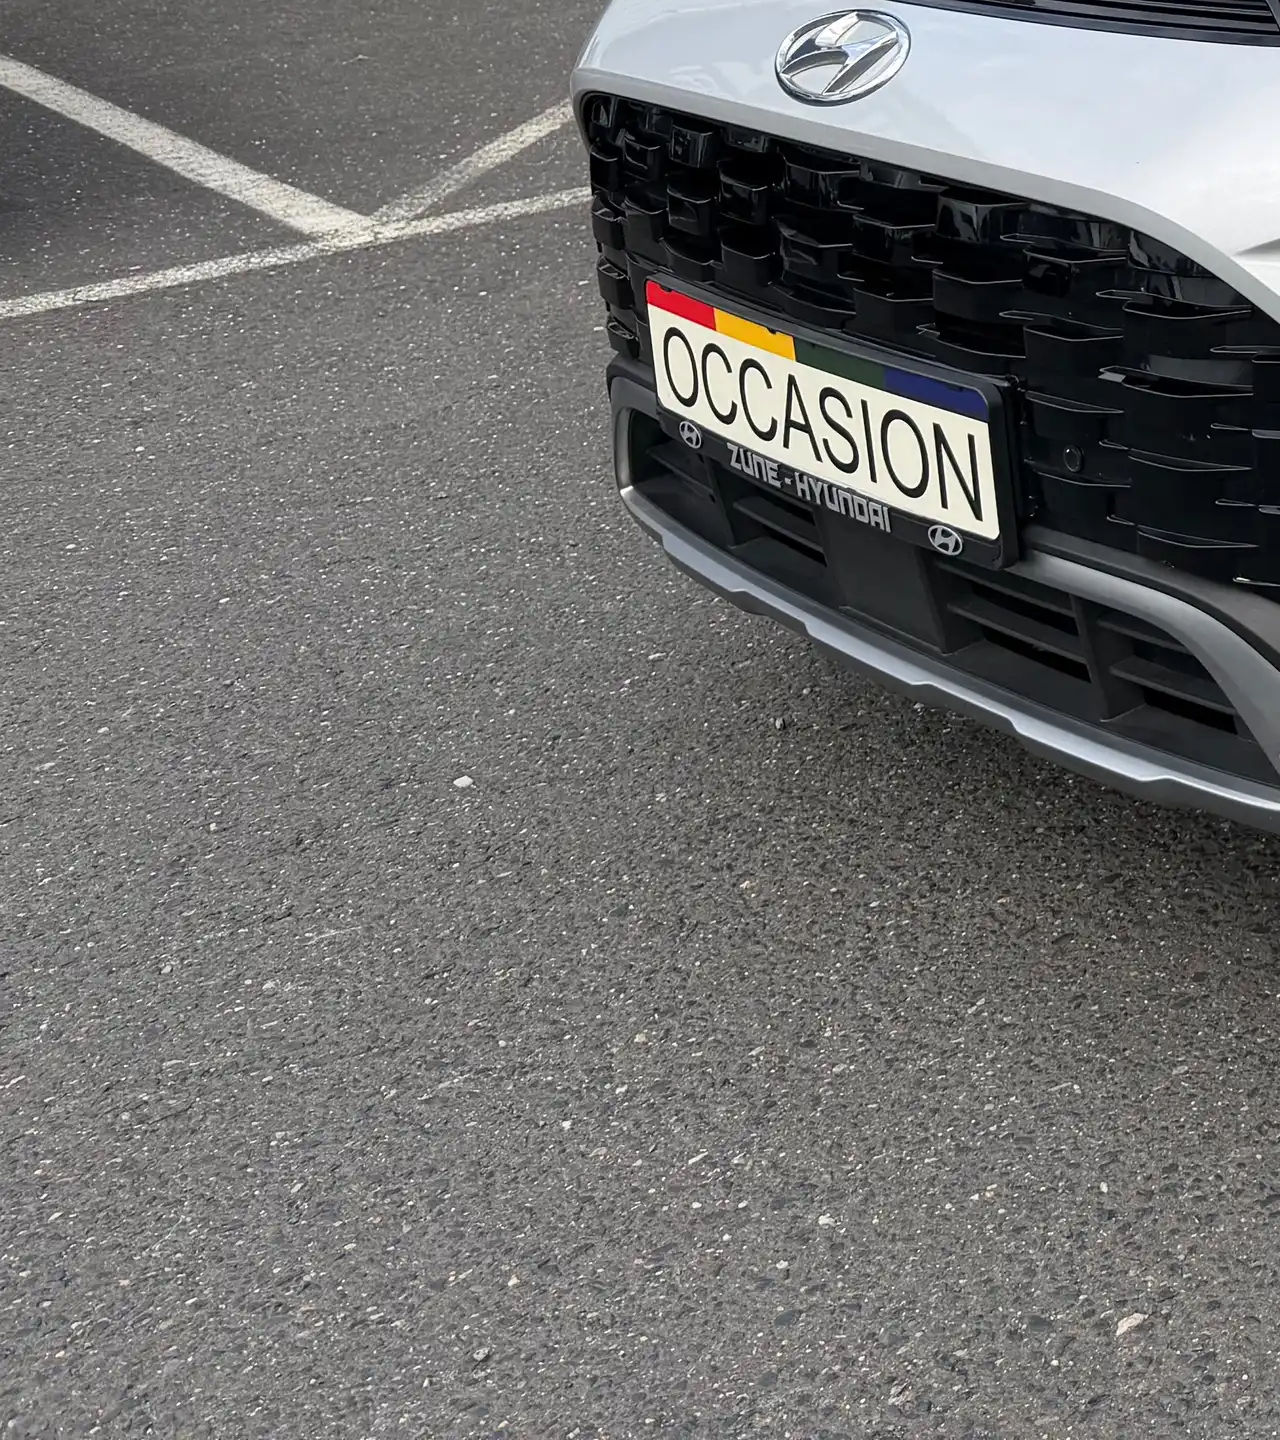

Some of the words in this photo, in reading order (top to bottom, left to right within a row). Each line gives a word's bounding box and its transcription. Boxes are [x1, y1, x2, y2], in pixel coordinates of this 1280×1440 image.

[662, 326, 984, 522] OCCASION
[727, 443, 782, 489] ZUNE
[795, 471, 892, 533] HYUNDAI
